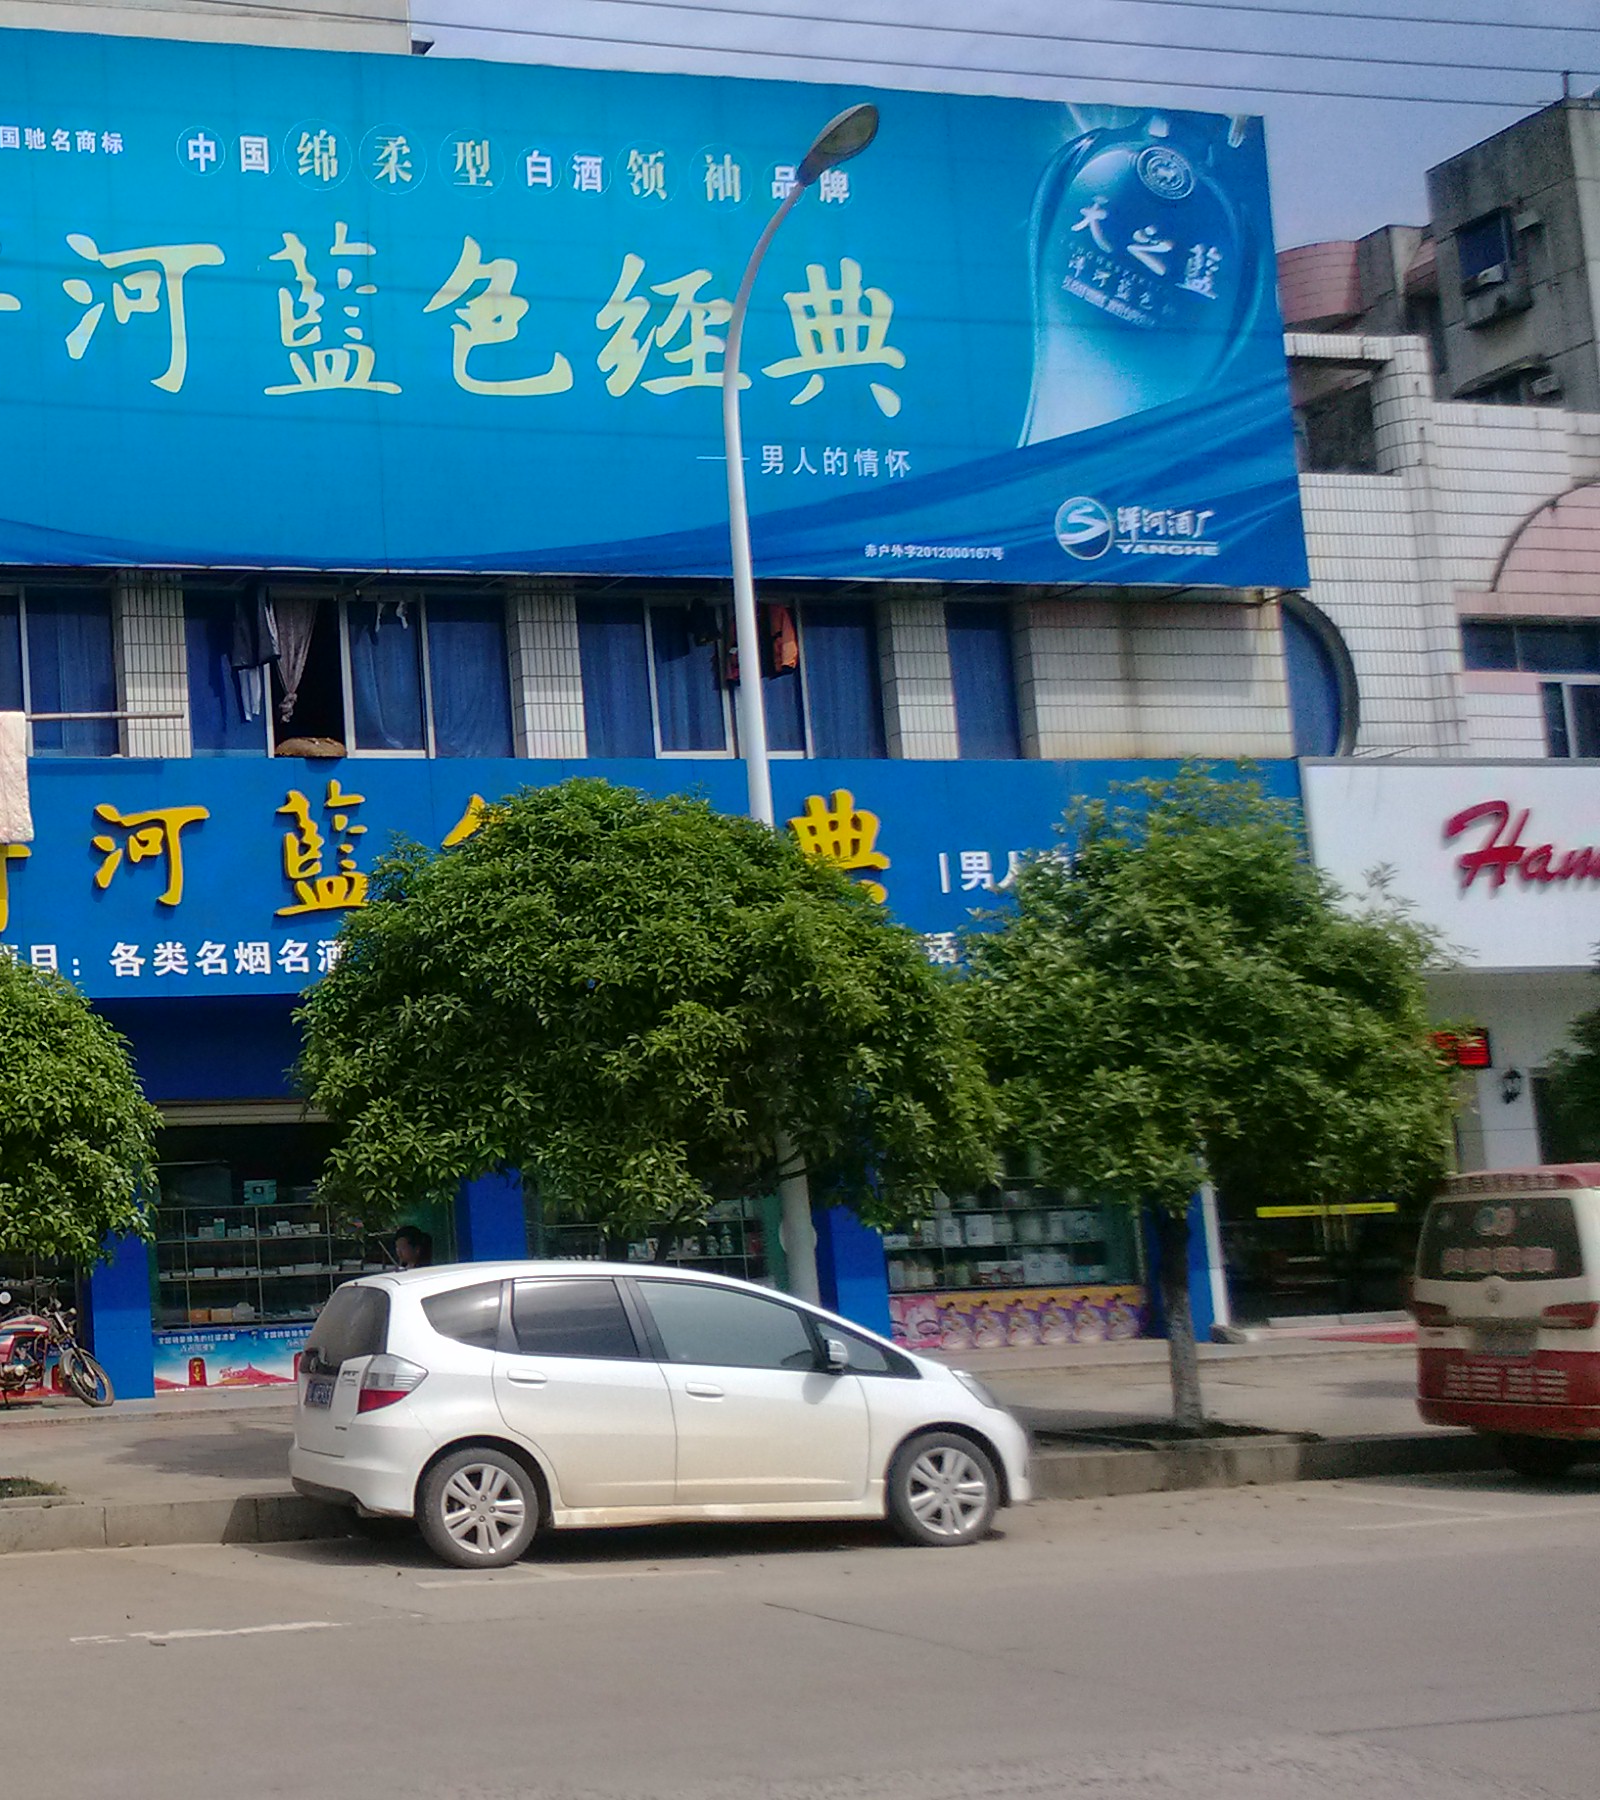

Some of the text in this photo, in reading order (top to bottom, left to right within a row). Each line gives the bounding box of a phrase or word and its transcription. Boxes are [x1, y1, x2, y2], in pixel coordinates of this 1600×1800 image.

[760, 445, 911, 478] 男人的情怀
[1117, 506, 1215, 545] 洋河酒厂
[1118, 545, 1219, 556] YANGHE
